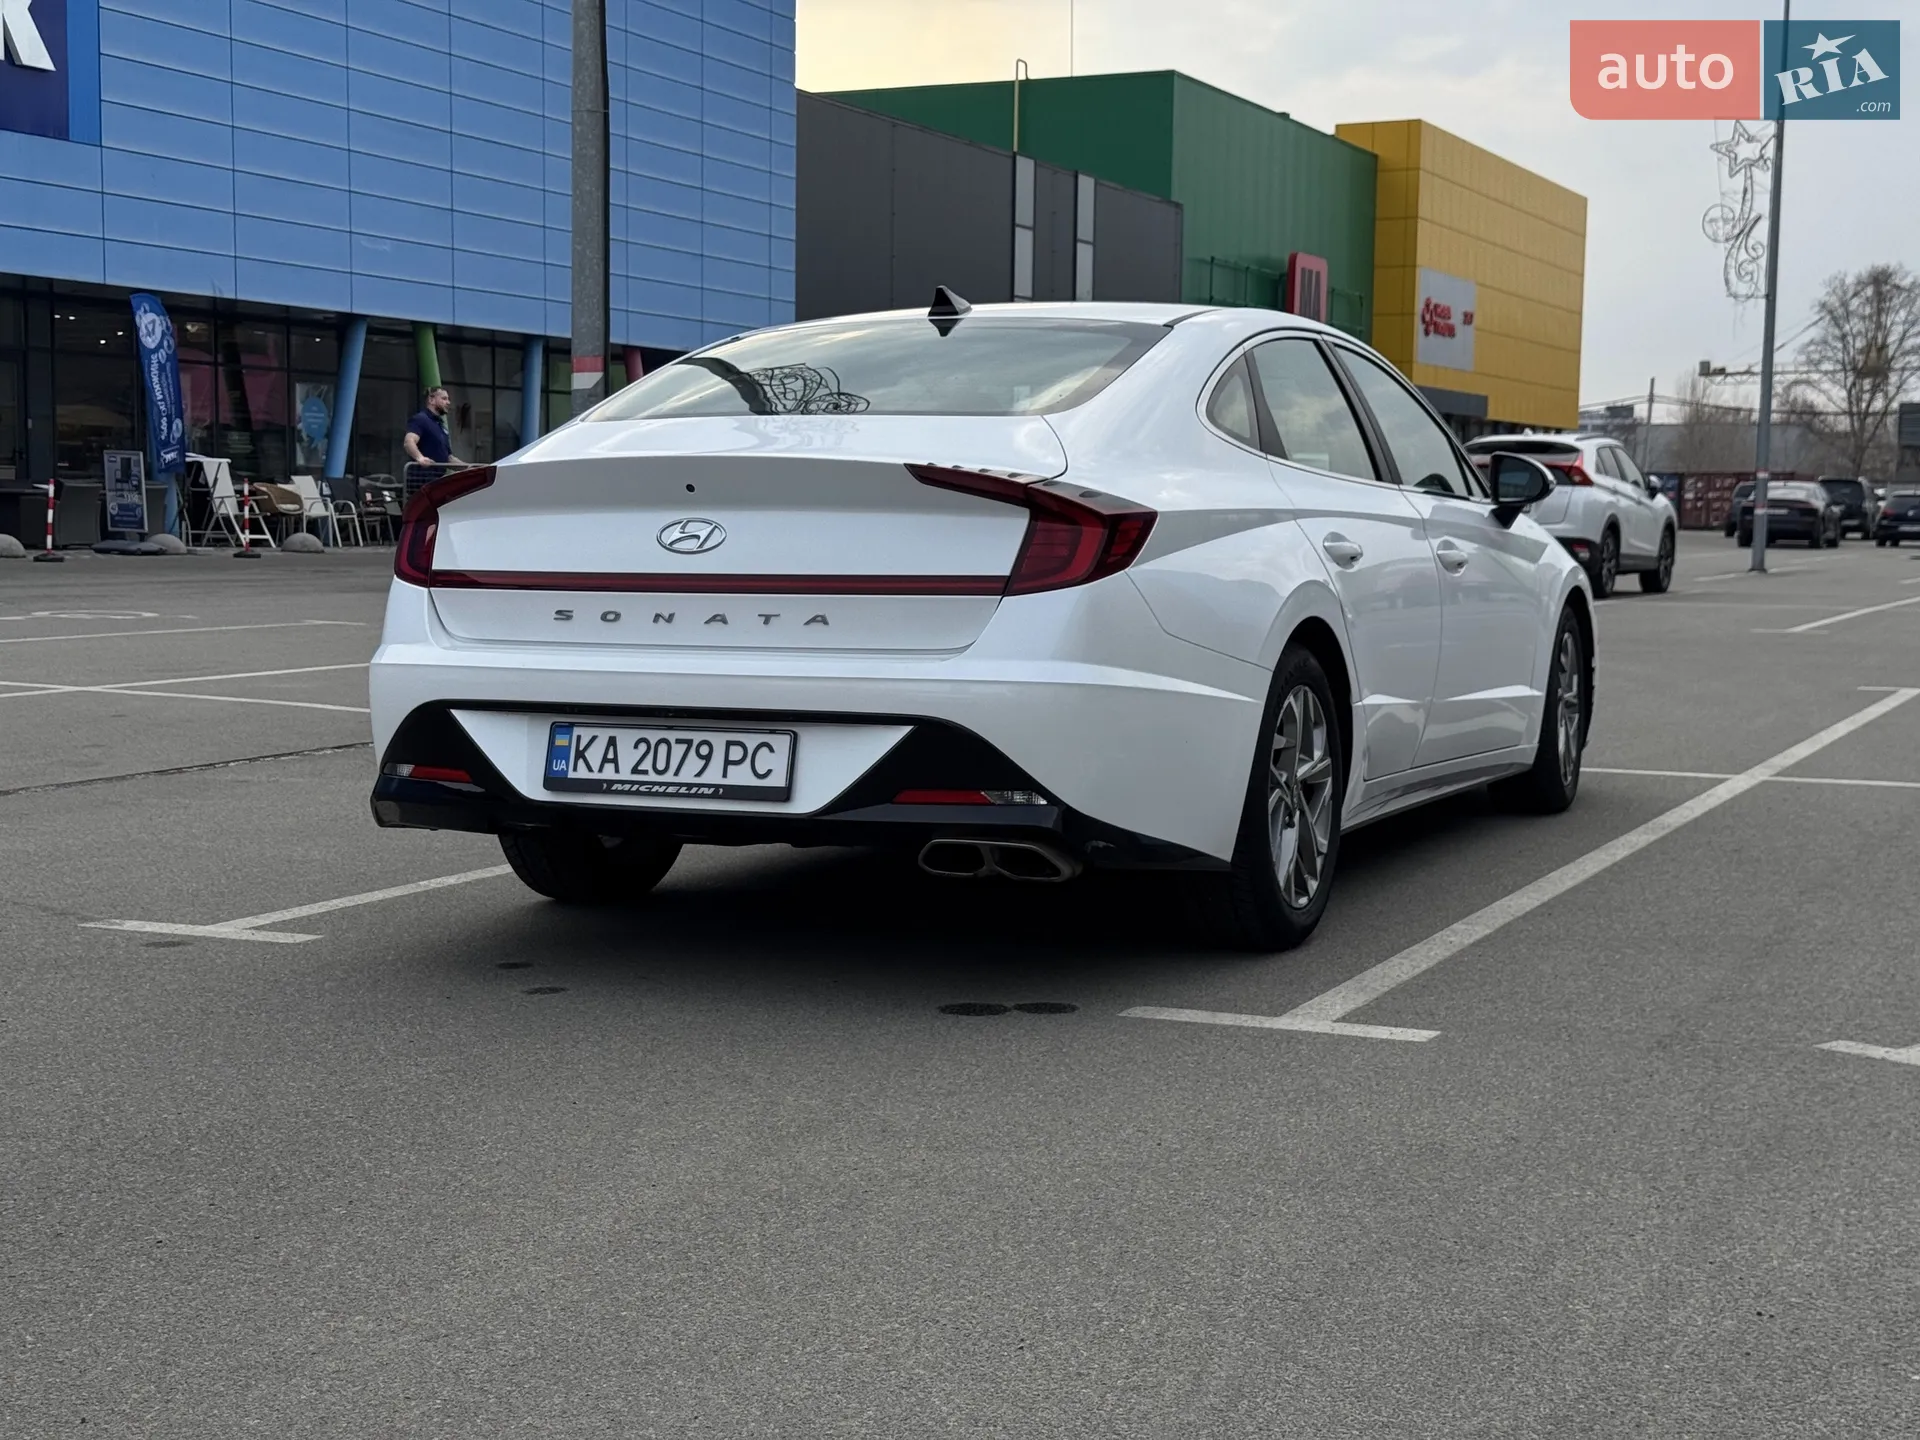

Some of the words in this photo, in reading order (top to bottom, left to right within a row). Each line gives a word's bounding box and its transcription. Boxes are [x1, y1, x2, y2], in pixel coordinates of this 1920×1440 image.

[553, 609, 830, 626] SONATA
[572, 735, 620, 774] KA
[631, 737, 714, 778] 2079
[722, 740, 776, 780] PC
[553, 759, 569, 771] UA
[610, 783, 716, 795] MICHELIN
